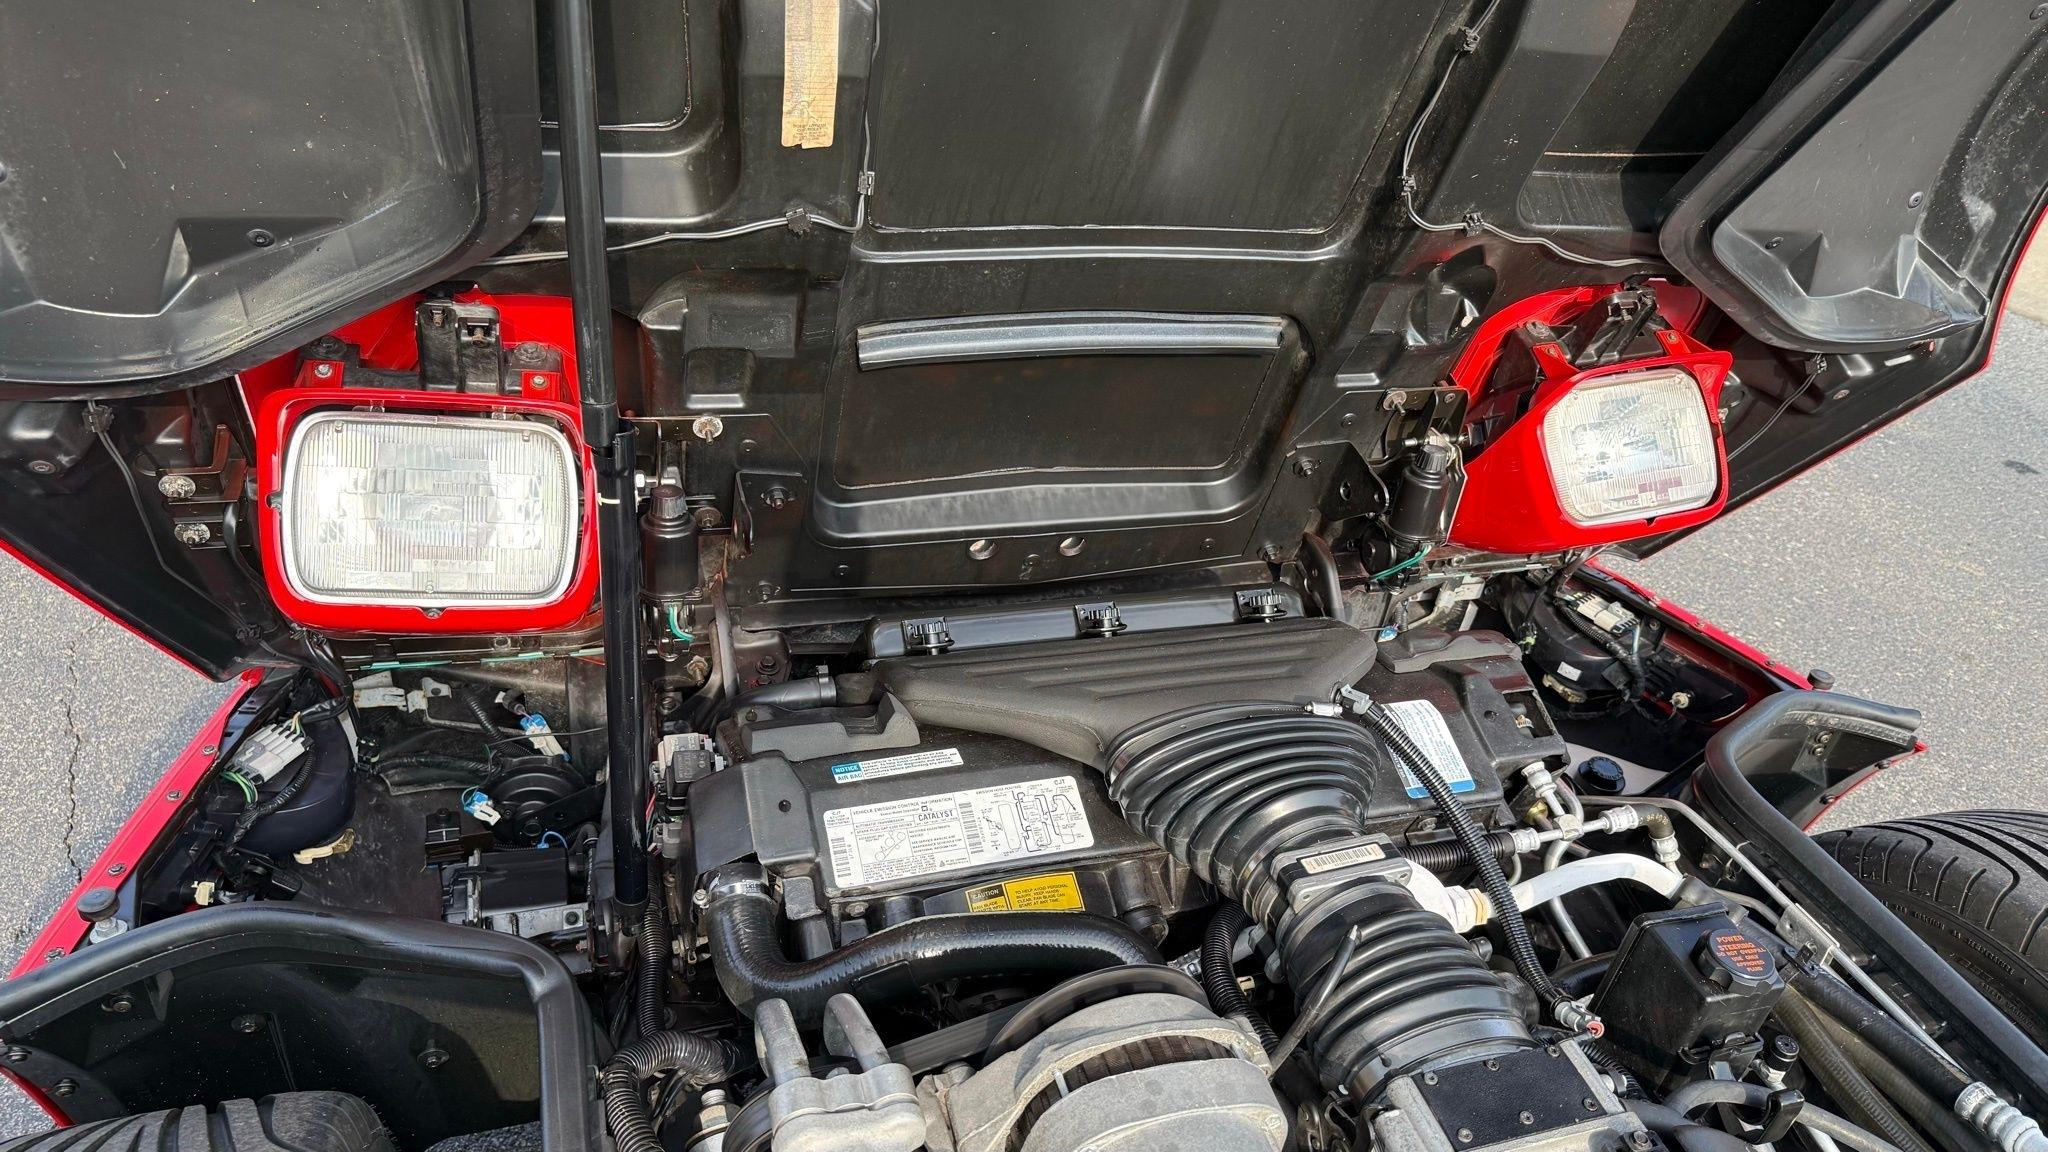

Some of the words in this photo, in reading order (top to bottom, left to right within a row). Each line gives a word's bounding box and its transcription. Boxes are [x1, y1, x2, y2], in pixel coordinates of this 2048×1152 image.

[918, 810, 953, 821] CATALYST
[973, 889, 999, 899] CAUTION
[1716, 935, 1744, 943] POWER
[1717, 942, 1756, 951] STEERING
